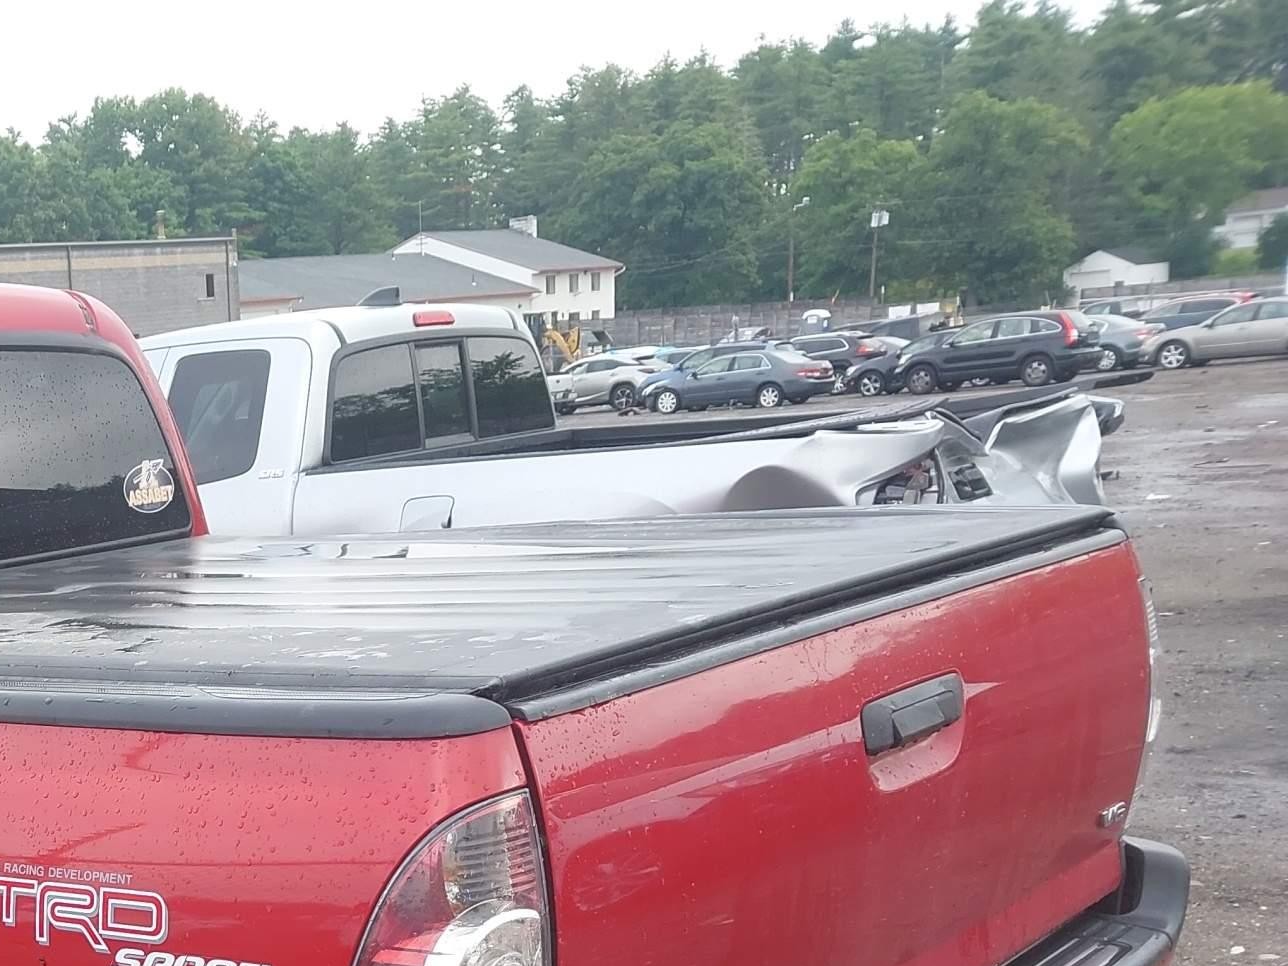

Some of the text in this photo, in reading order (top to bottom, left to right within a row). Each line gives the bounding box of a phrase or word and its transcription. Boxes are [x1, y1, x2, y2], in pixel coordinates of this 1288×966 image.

[129, 485, 172, 507] ASSABET
[3, 862, 45, 877] RACING
[48, 867, 133, 885] DEVELOPMENT
